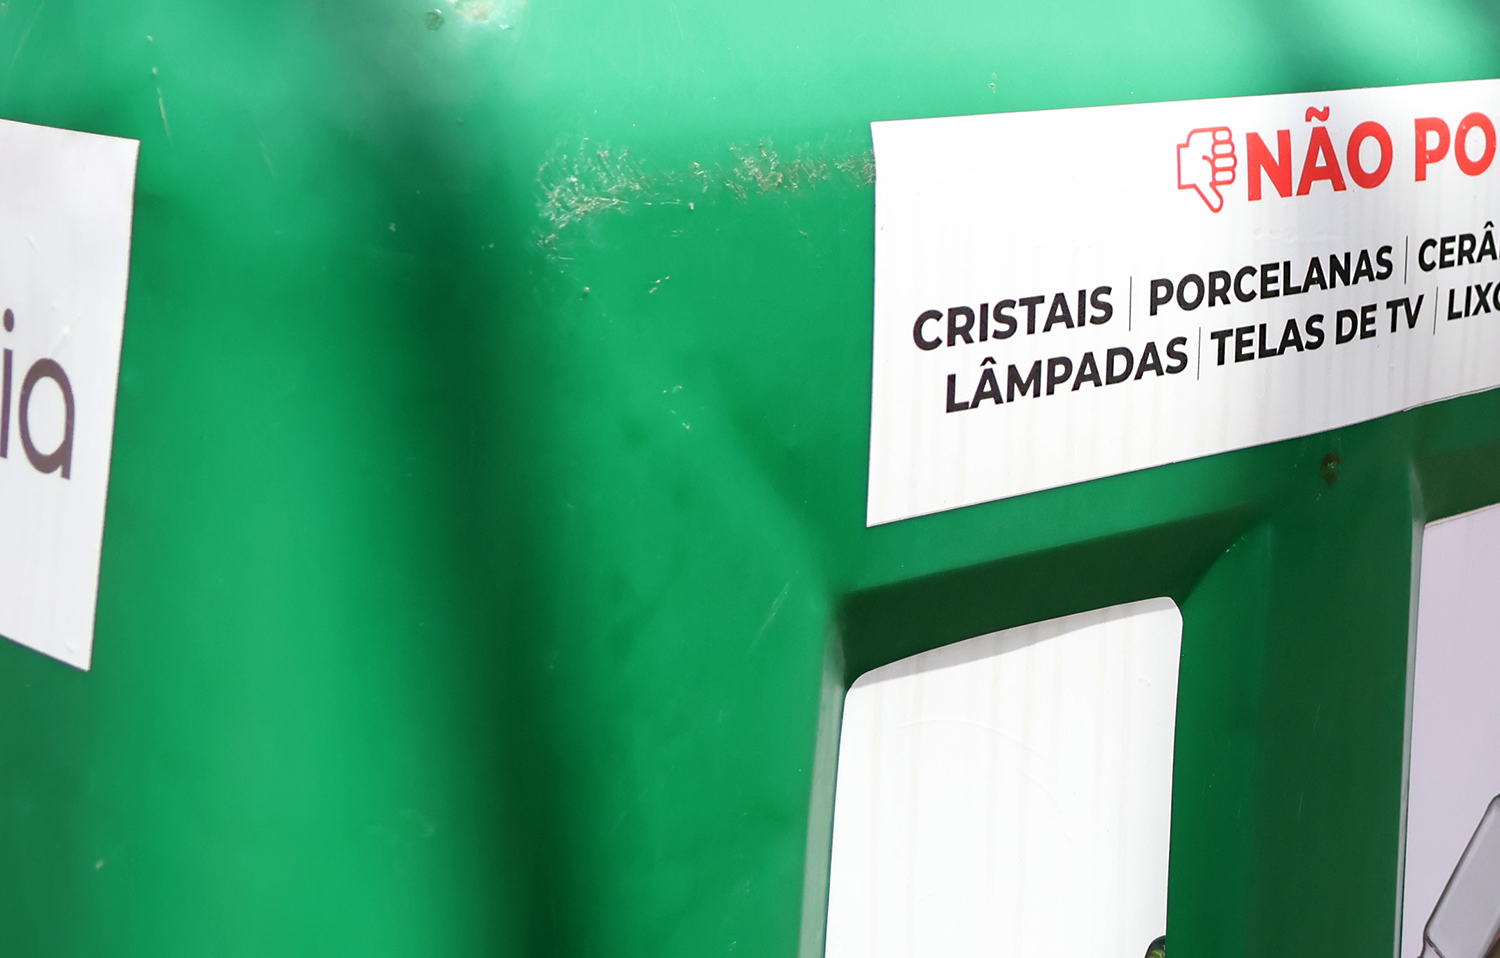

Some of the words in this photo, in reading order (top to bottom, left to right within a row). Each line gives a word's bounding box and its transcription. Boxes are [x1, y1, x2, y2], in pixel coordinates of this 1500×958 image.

[1246, 106, 1393, 201] NÃO
[914, 286, 1113, 350] CRISTAIS
[1150, 246, 1393, 316] PORCELANAS
[946, 337, 1187, 413] LÂMPADAS
[1211, 314, 1324, 366] TELAS
[1336, 304, 1377, 345] DE
[1386, 294, 1424, 333] TV
